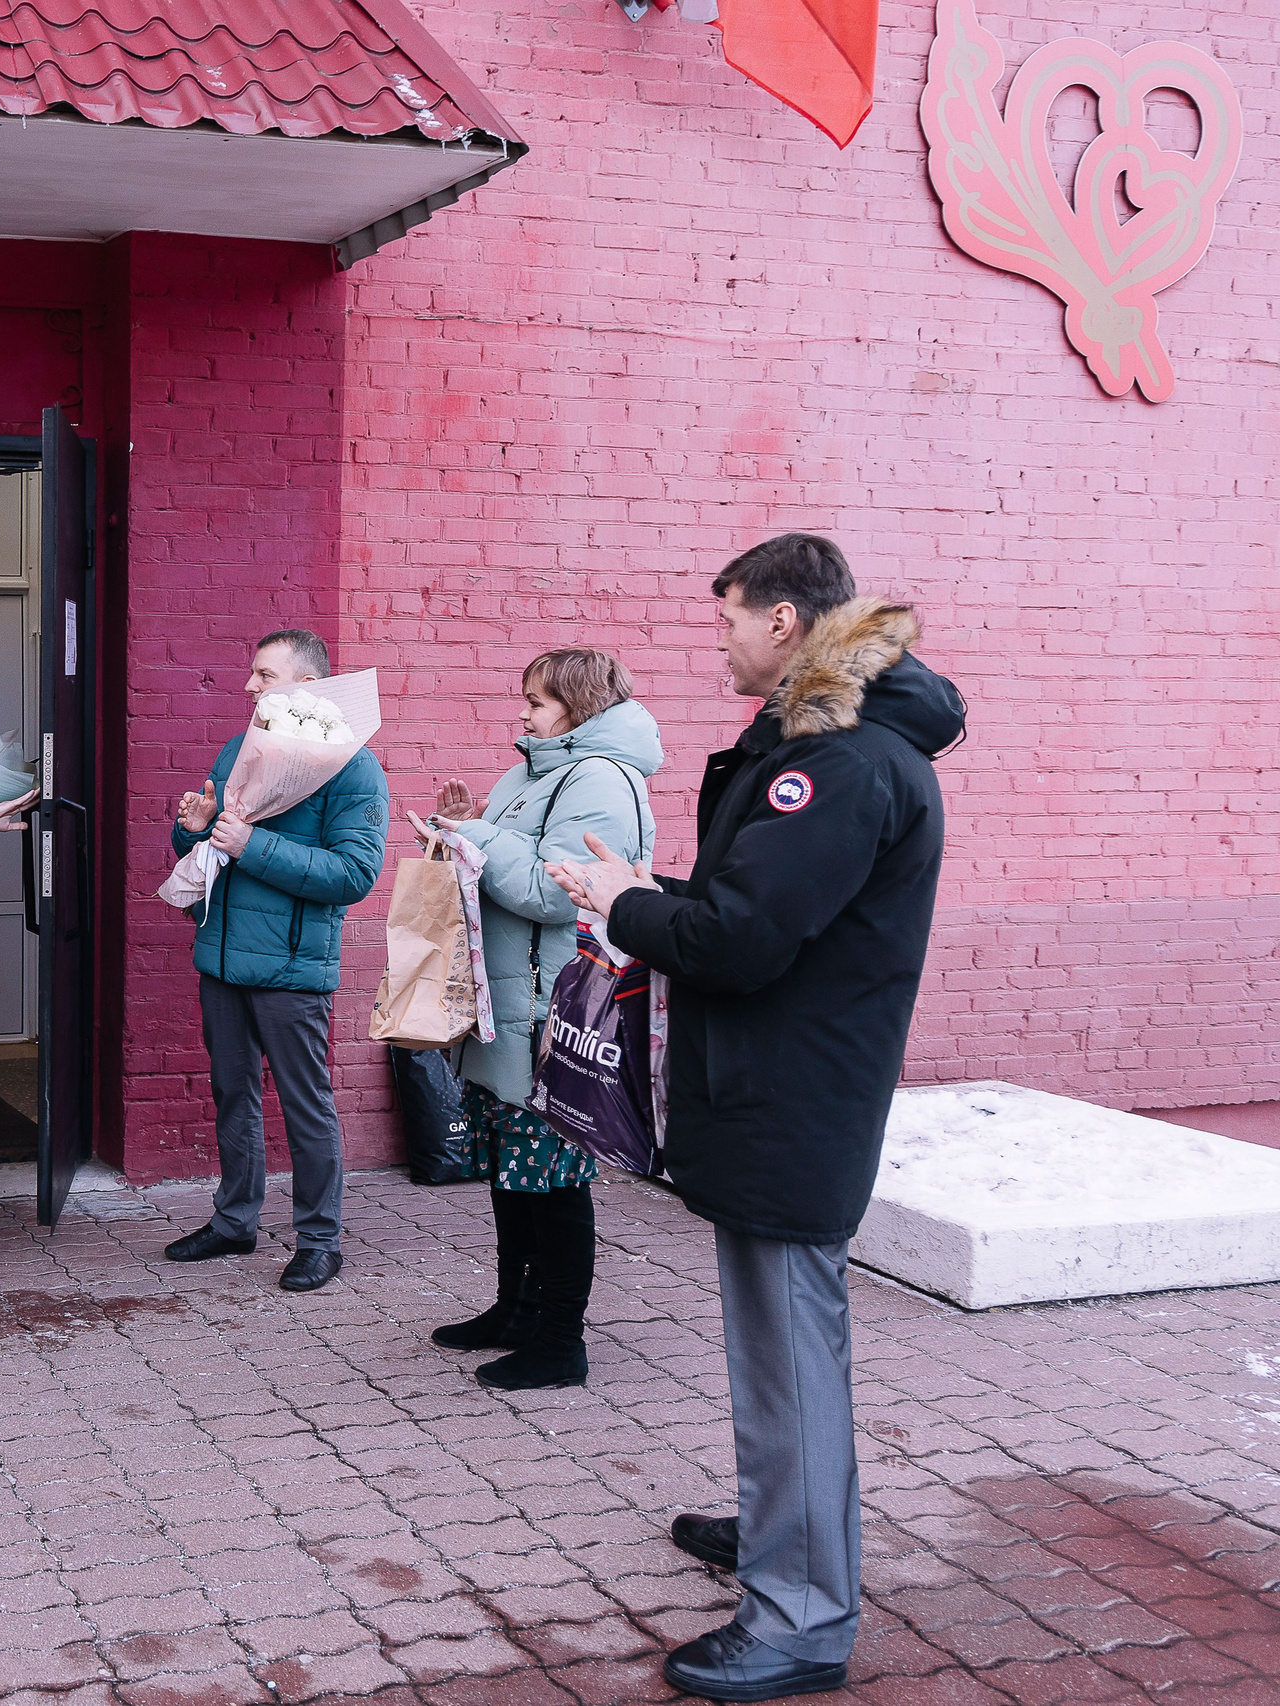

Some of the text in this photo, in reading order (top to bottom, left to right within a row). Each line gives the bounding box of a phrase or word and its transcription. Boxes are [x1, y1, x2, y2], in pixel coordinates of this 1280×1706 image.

[548, 1004, 622, 1068] familia
[588, 1071, 598, 1079] от
[599, 1075, 619, 1085] цен
